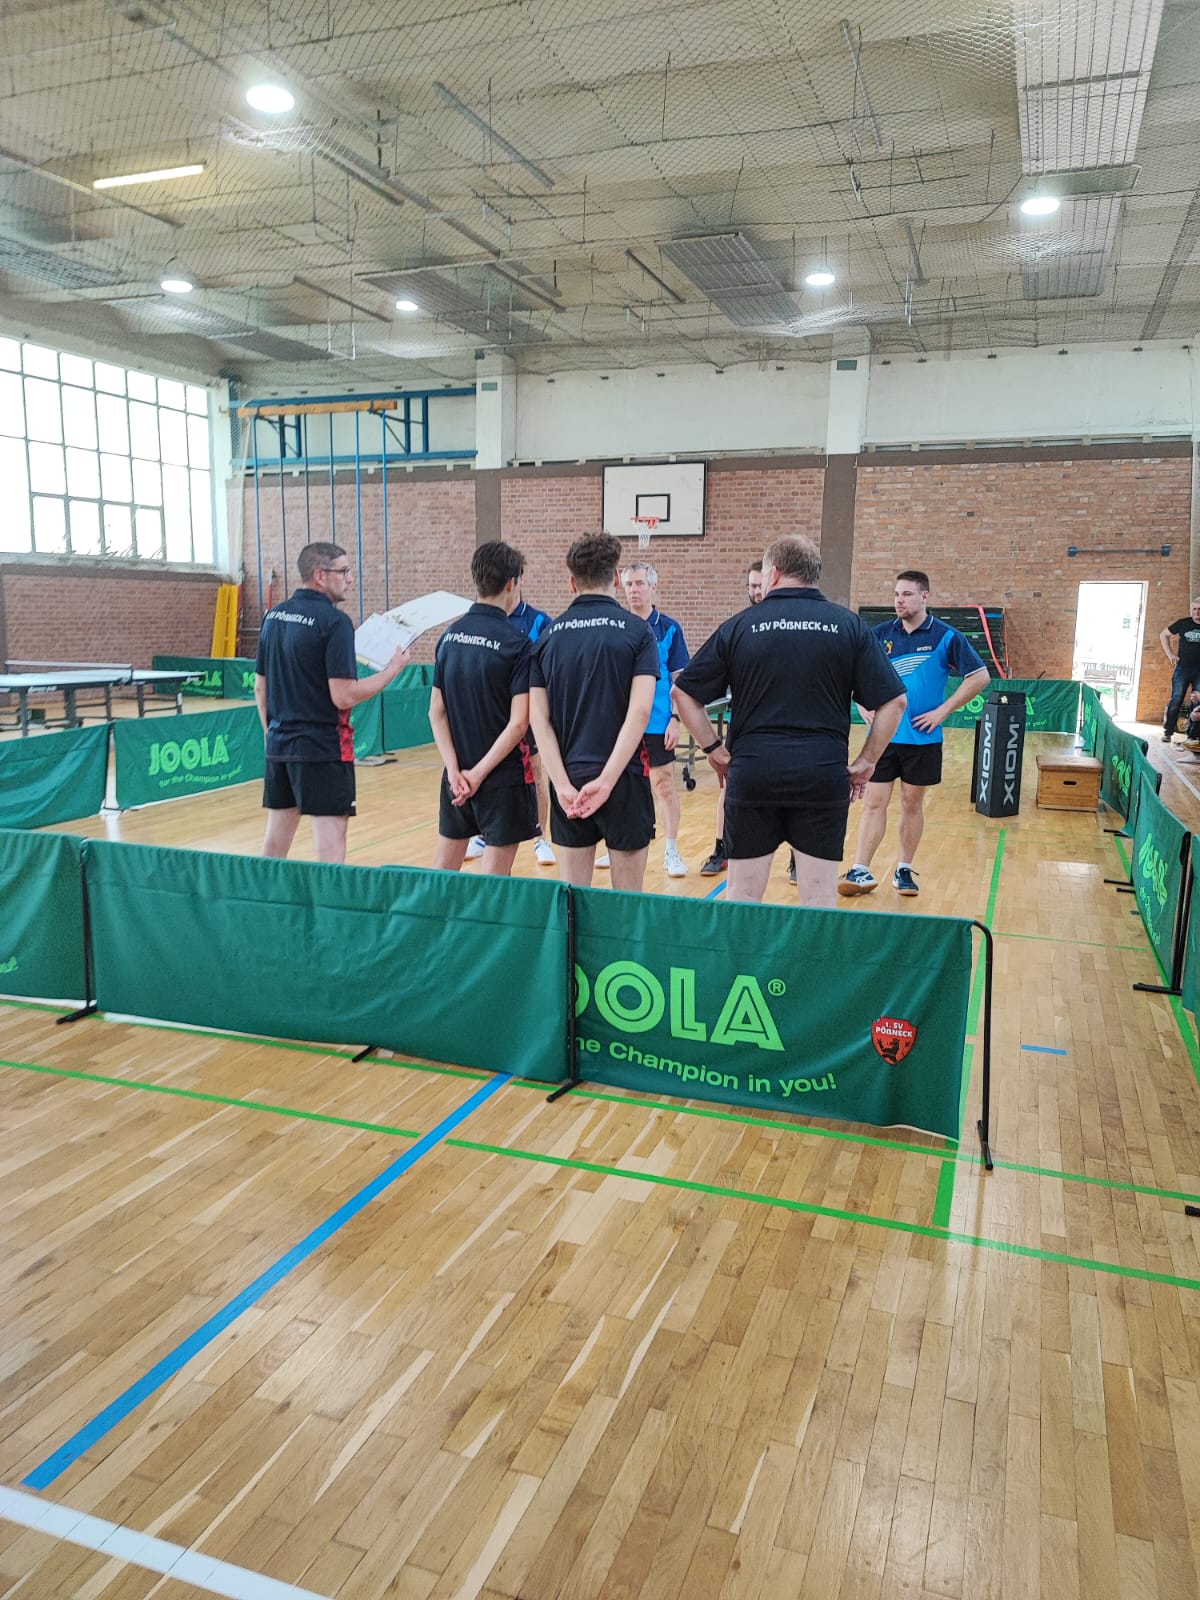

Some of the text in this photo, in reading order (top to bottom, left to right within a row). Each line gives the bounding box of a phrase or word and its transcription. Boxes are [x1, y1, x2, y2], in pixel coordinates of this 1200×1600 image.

[751, 618, 839, 634] 1. SV PÖßNECK e.V.
[979, 721, 993, 804] XIOM
[1003, 723, 1020, 806] XIOM
[893, 1022, 904, 1030] SV
[609, 1041, 739, 1090] Champion
[748, 1074, 771, 1093] in
[778, 1072, 837, 1097] you!
